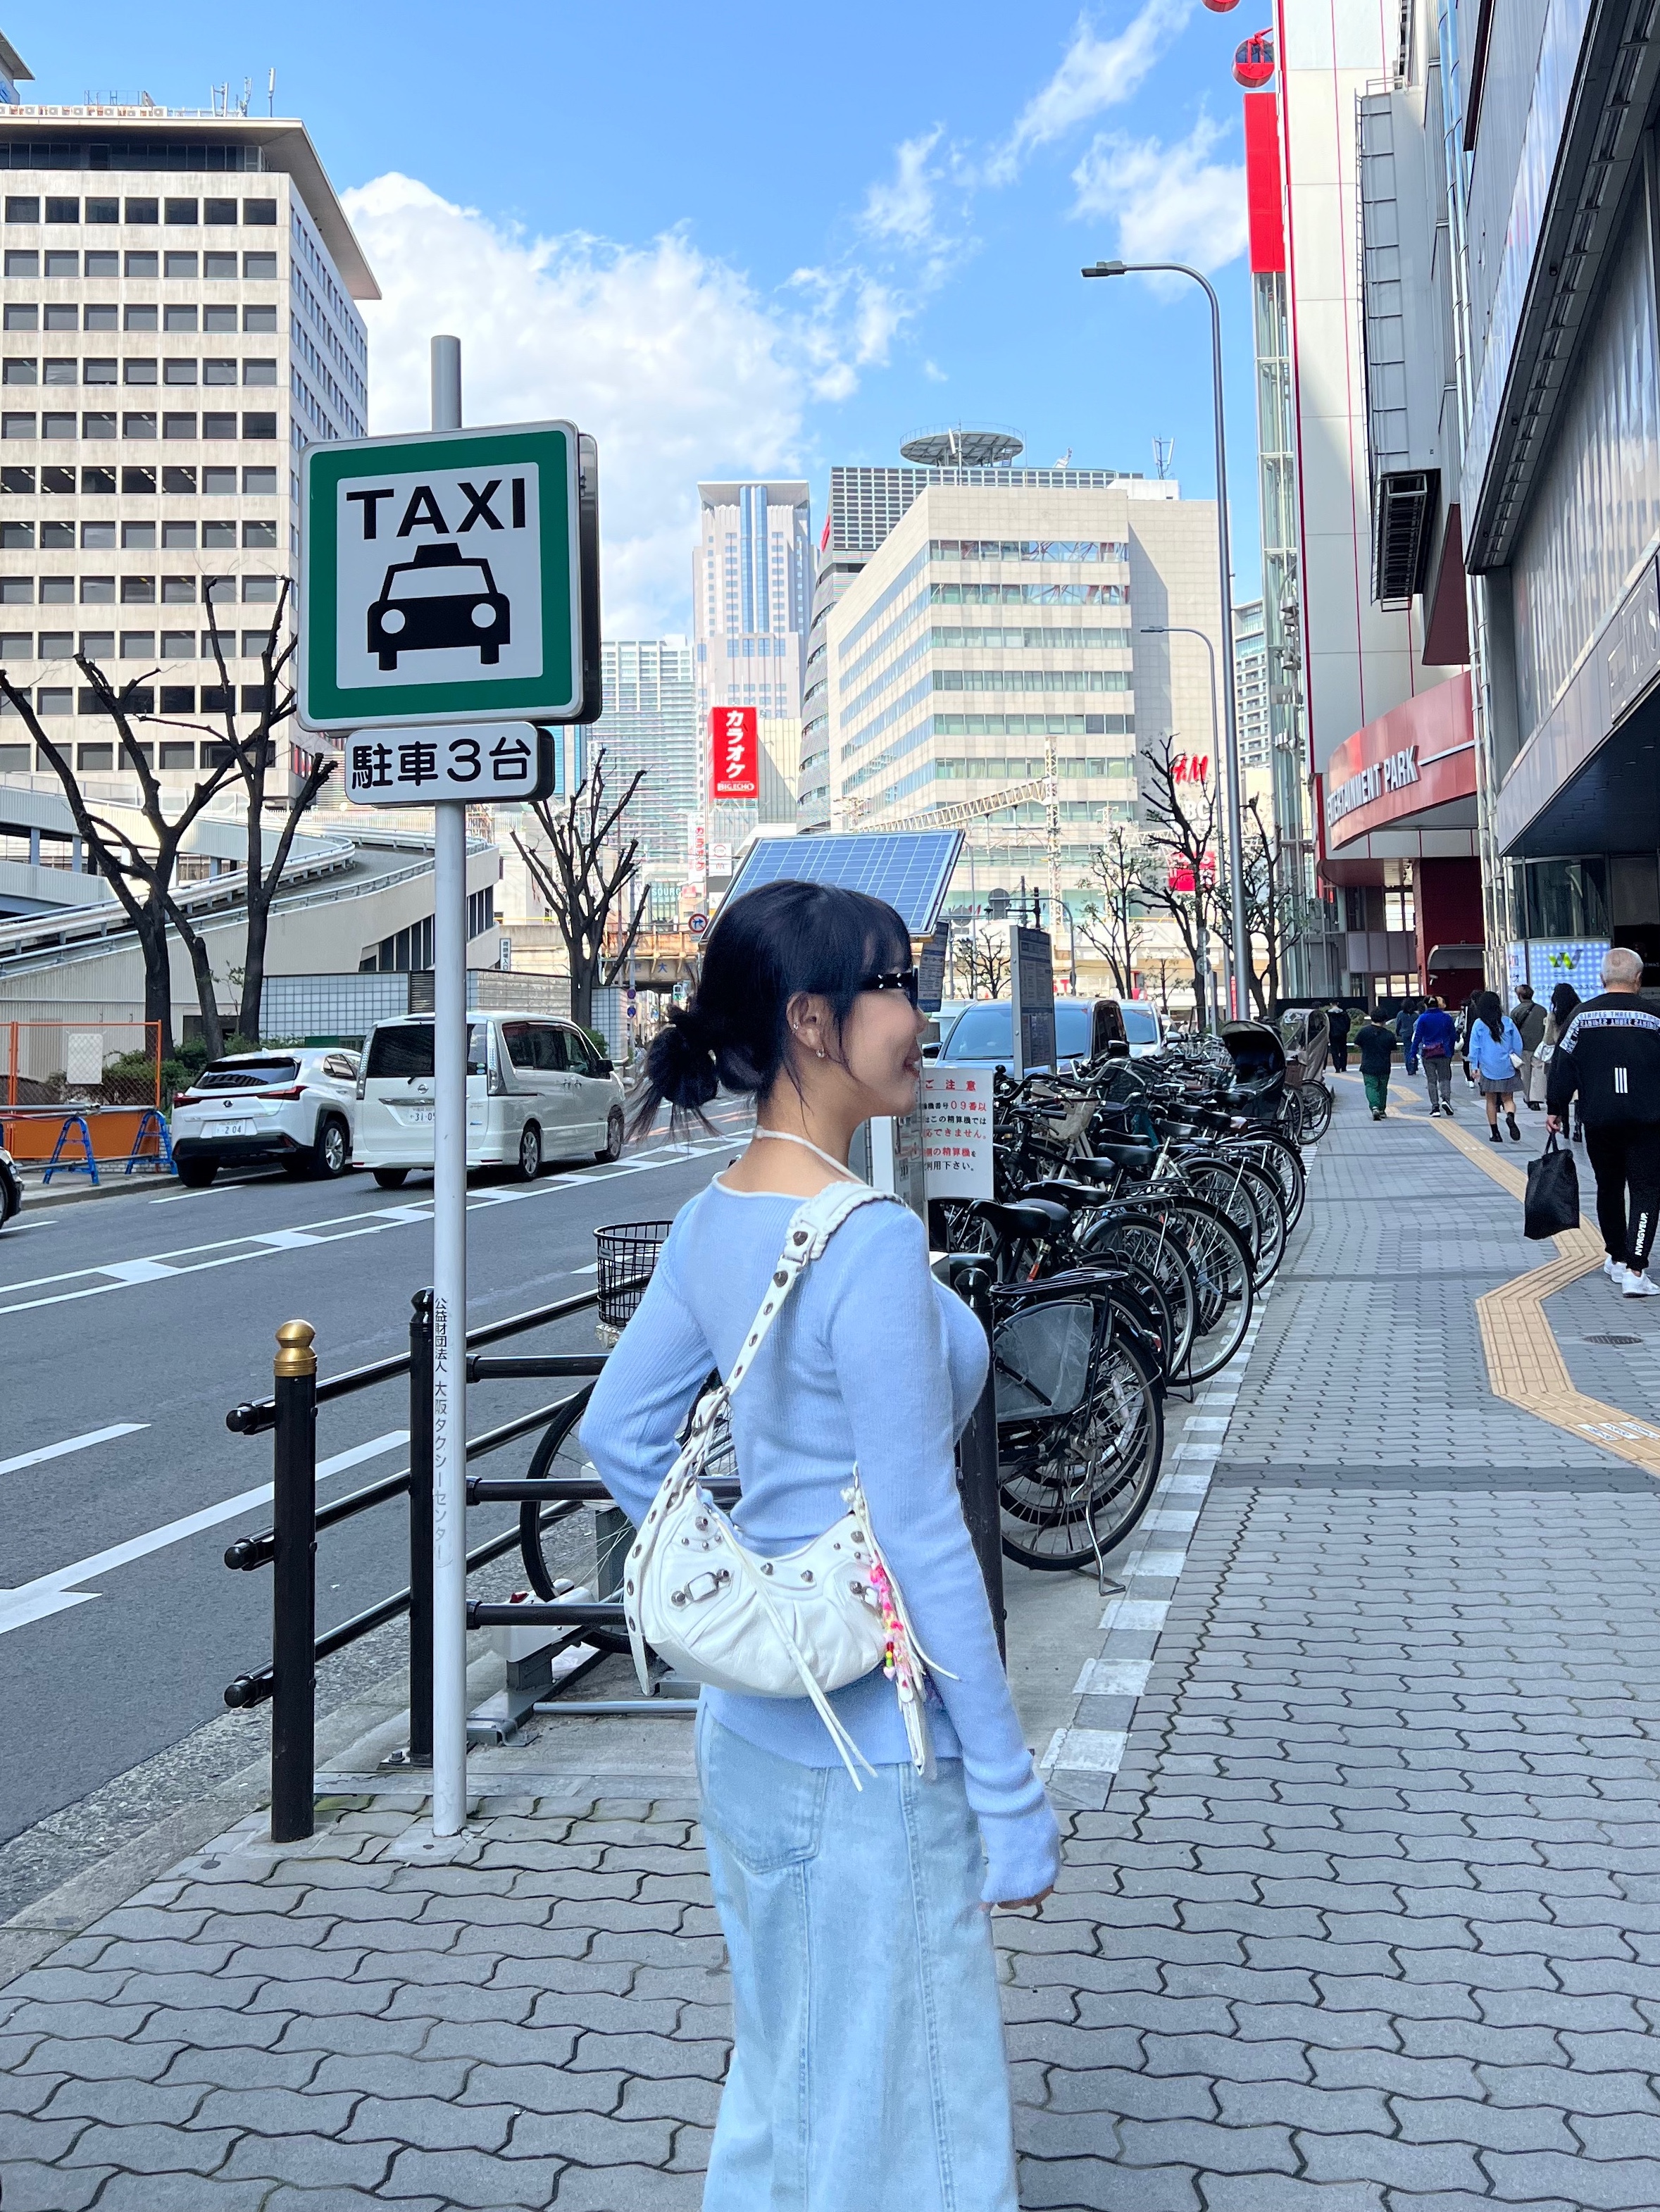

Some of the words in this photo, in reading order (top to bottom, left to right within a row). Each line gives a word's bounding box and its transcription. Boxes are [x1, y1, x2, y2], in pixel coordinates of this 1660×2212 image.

[347, 478, 526, 539] TAXI
[351, 737, 531, 789] 駐車3台
[725, 709, 745, 779] カラオケ
[1383, 745, 1418, 792] PARK
[717, 783, 732, 792] BIG
[733, 783, 755, 792] ECHO
[435, 1296, 448, 1373] 公益財団法人
[434, 1380, 448, 1561] 大阪タクシーセンター
